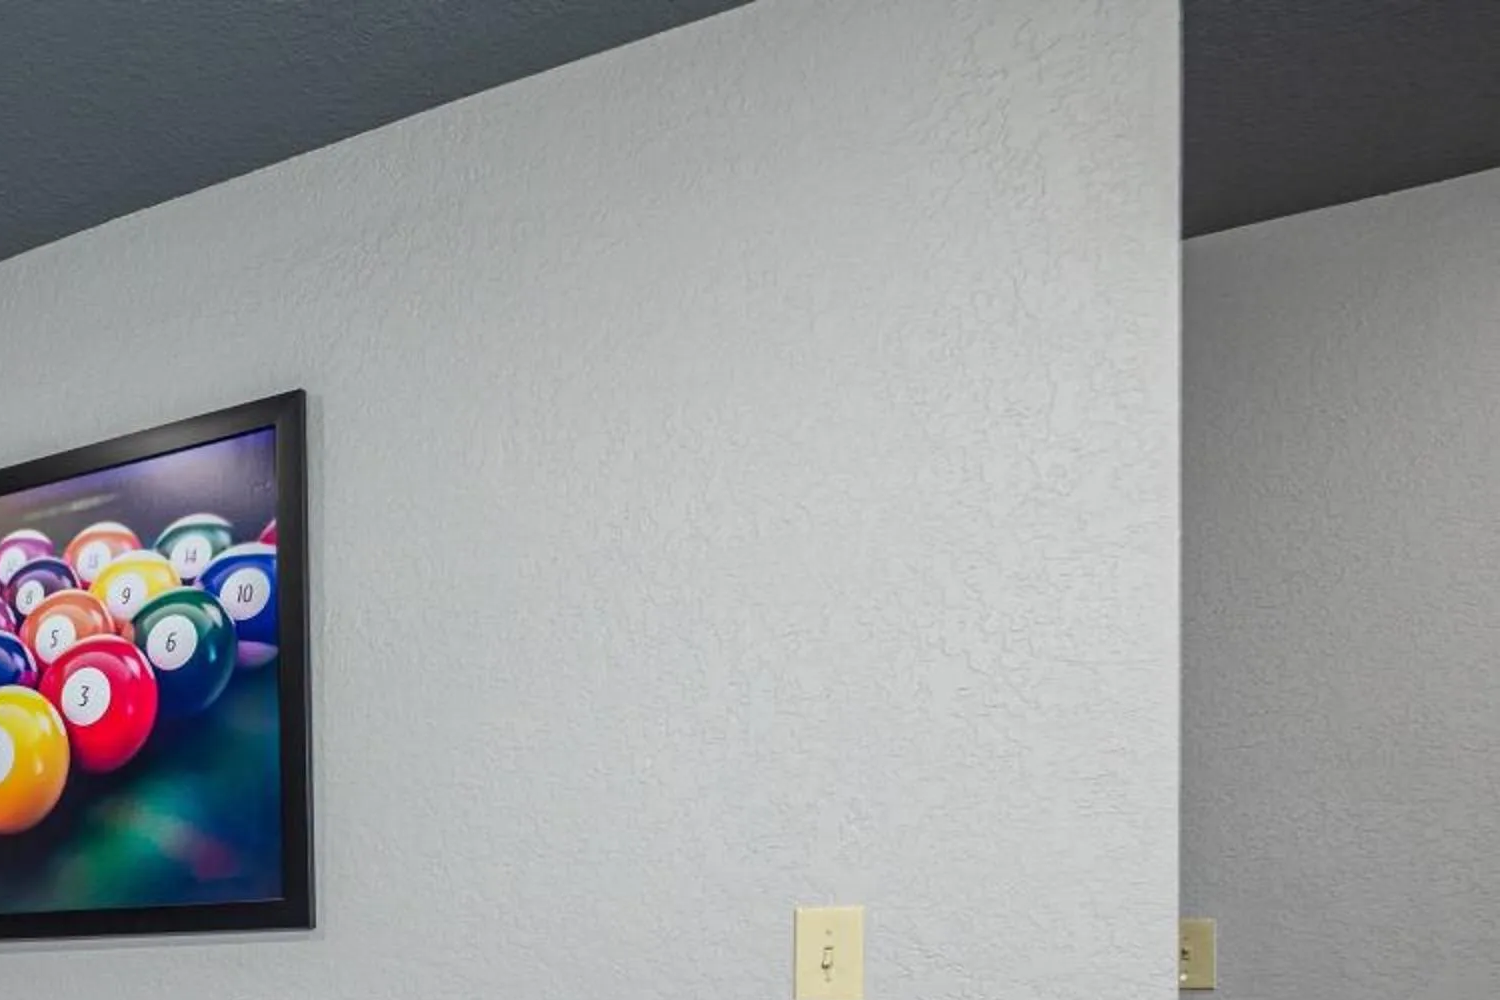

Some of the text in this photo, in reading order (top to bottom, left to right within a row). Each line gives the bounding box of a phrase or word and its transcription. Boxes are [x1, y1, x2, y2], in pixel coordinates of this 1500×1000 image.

[121, 586, 131, 605] 9
[236, 583, 253, 603] 10
[50, 628, 59, 649] 5
[165, 632, 177, 652] 6
[78, 685, 90, 707] 3
